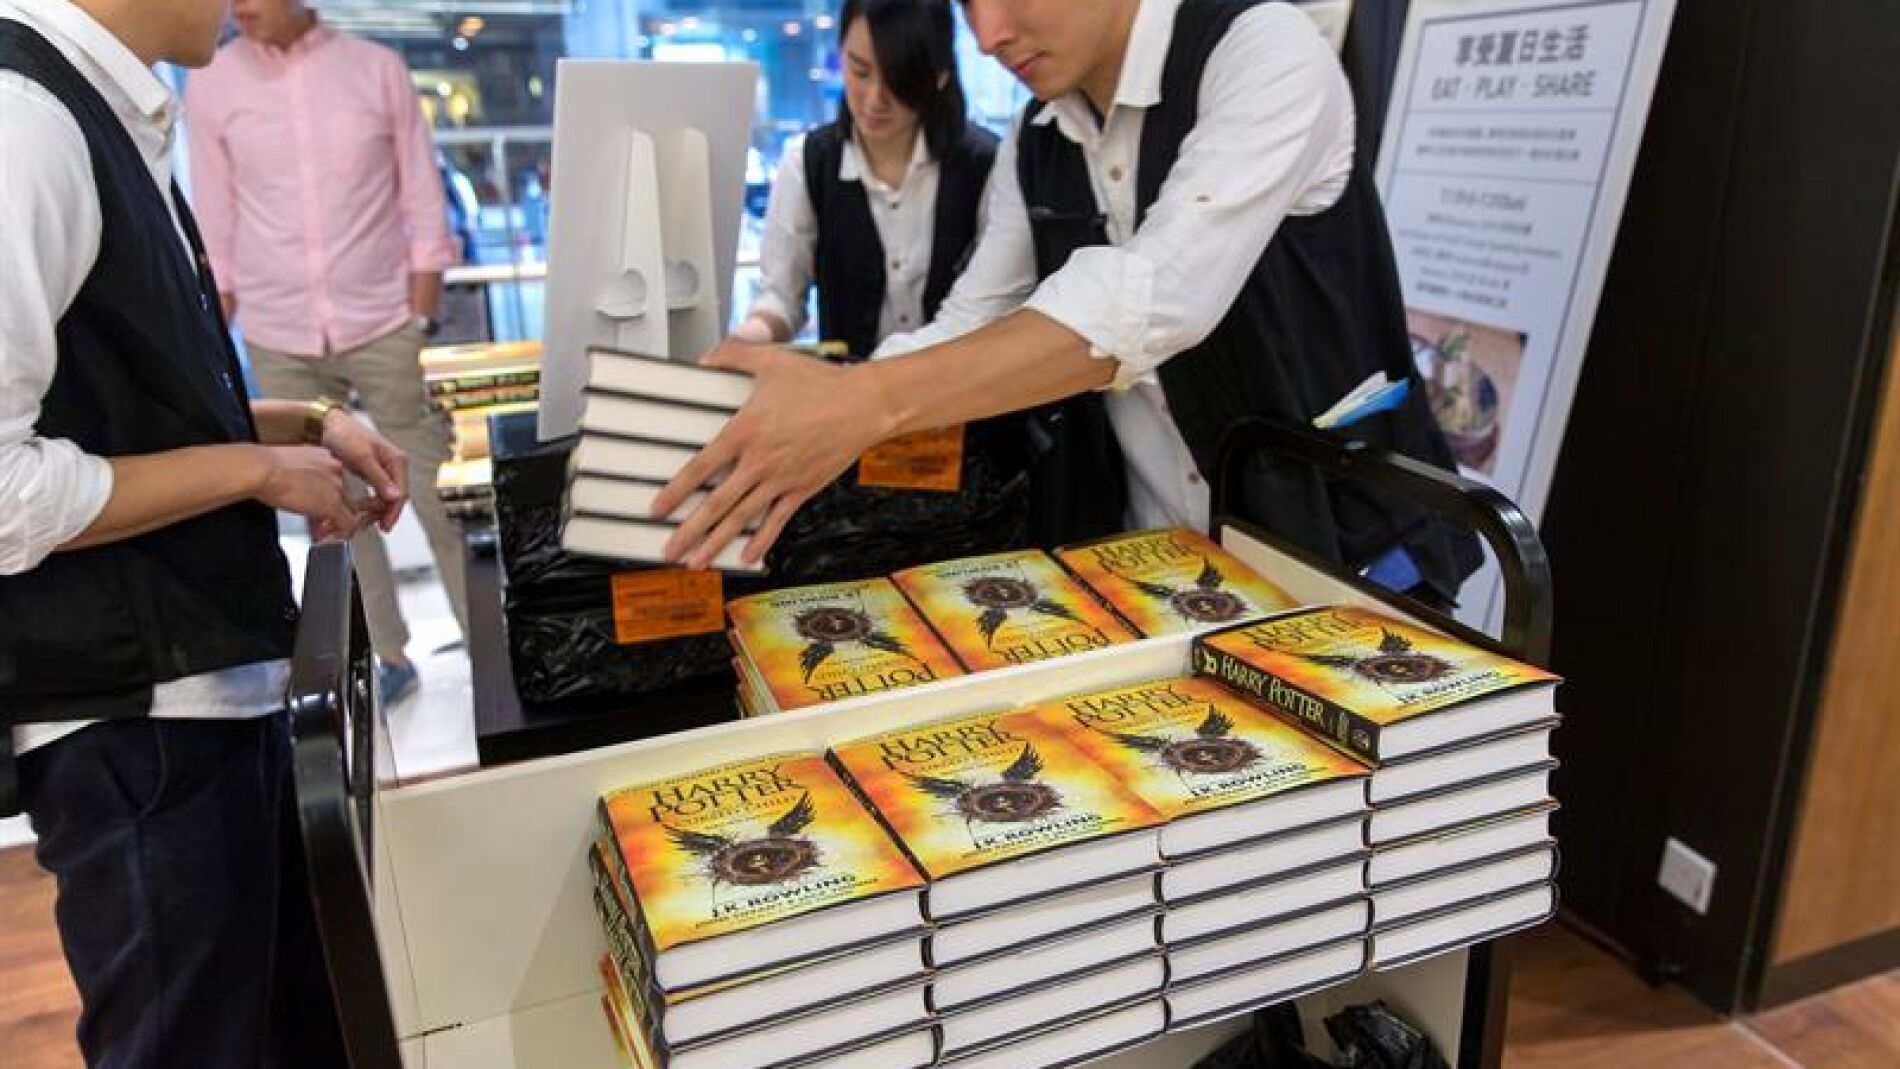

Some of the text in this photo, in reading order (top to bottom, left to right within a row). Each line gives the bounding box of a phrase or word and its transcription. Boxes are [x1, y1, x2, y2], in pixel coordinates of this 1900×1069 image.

[1431, 70, 1597, 101] EAT PLAY SHARE
[1000, 627, 1110, 665] POTTER
[815, 662, 937, 701] POTTER
[1222, 655, 1268, 697] HARRY
[1268, 676, 1325, 728] POTTER
[1065, 684, 1171, 718] HARRY
[1072, 695, 1193, 728] POTTER
[880, 719, 998, 757] HARRY
[880, 730, 1016, 770] POTTER
[648, 778, 802, 823] POTTER
[652, 764, 780, 806] HARRY
[1003, 810, 1103, 841] ROWLING
[747, 873, 857, 908] ROWLING
